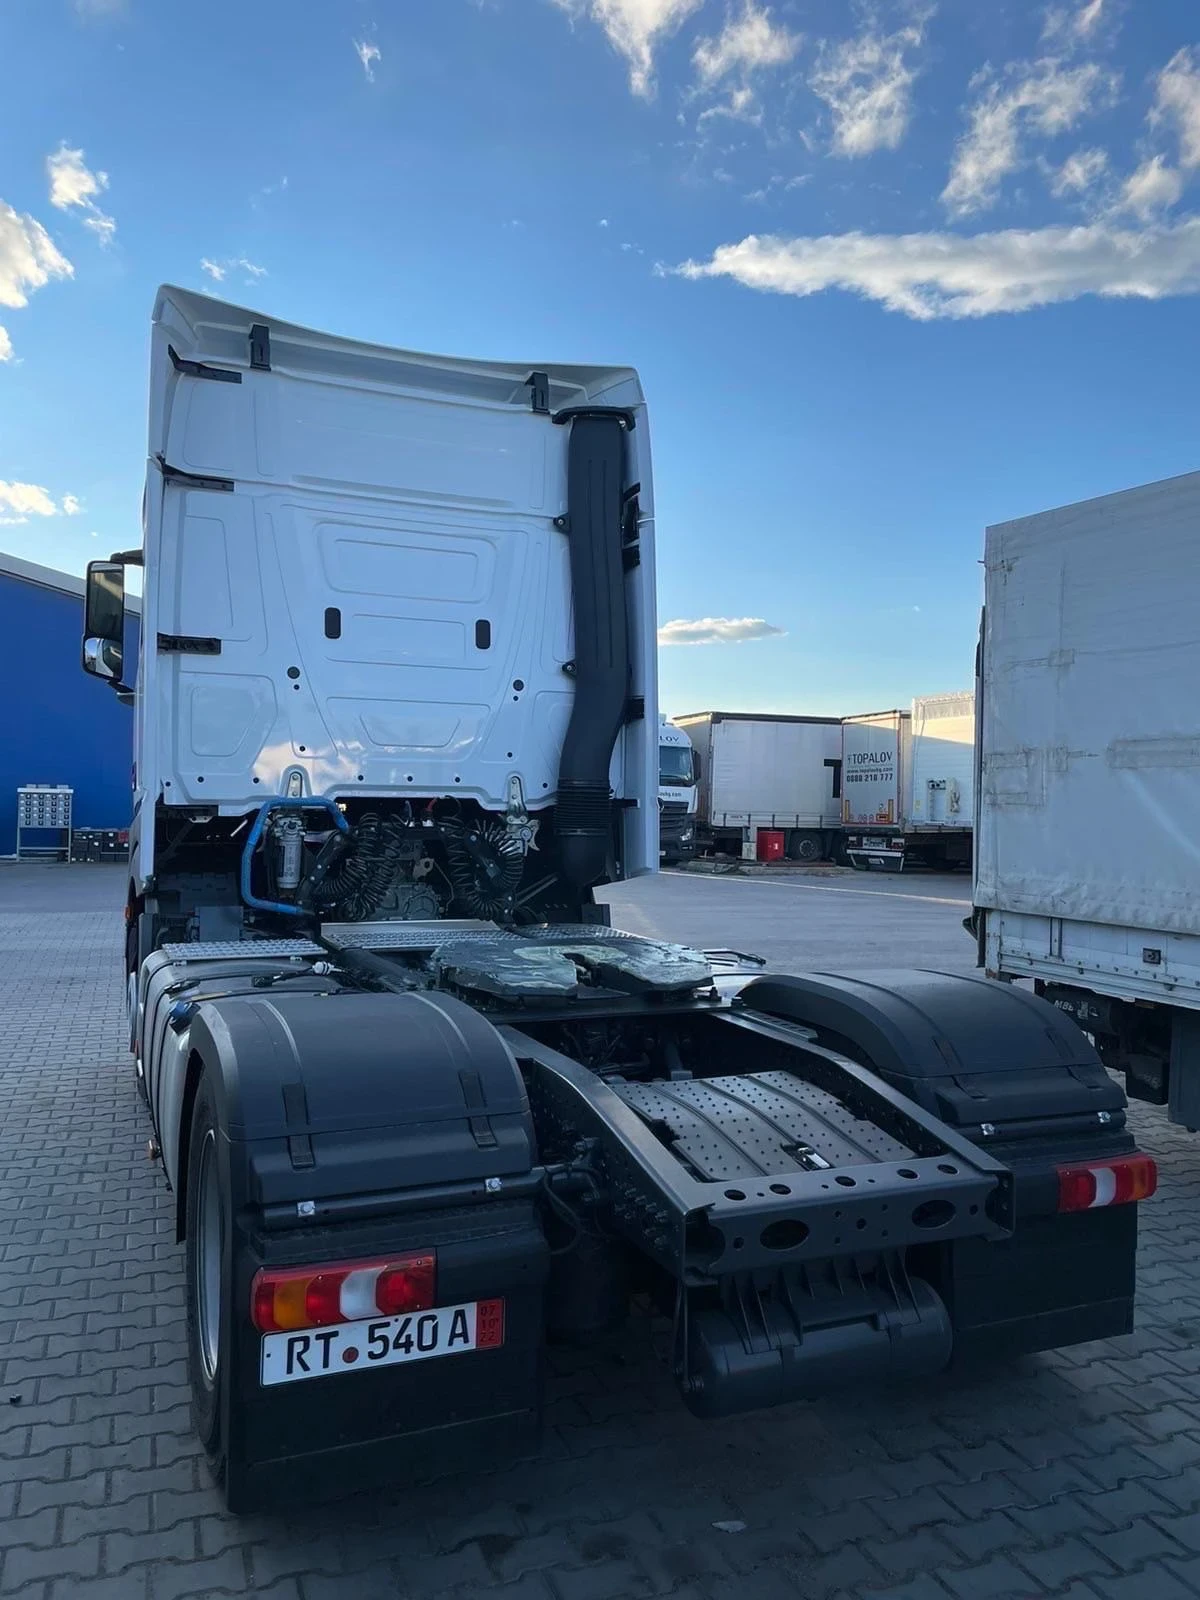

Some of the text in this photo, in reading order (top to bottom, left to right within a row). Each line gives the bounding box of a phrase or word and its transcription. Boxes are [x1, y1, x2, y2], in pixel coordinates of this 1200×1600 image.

[853, 751, 893, 765] TOPALOV
[286, 1308, 470, 1375] RT 540 A
